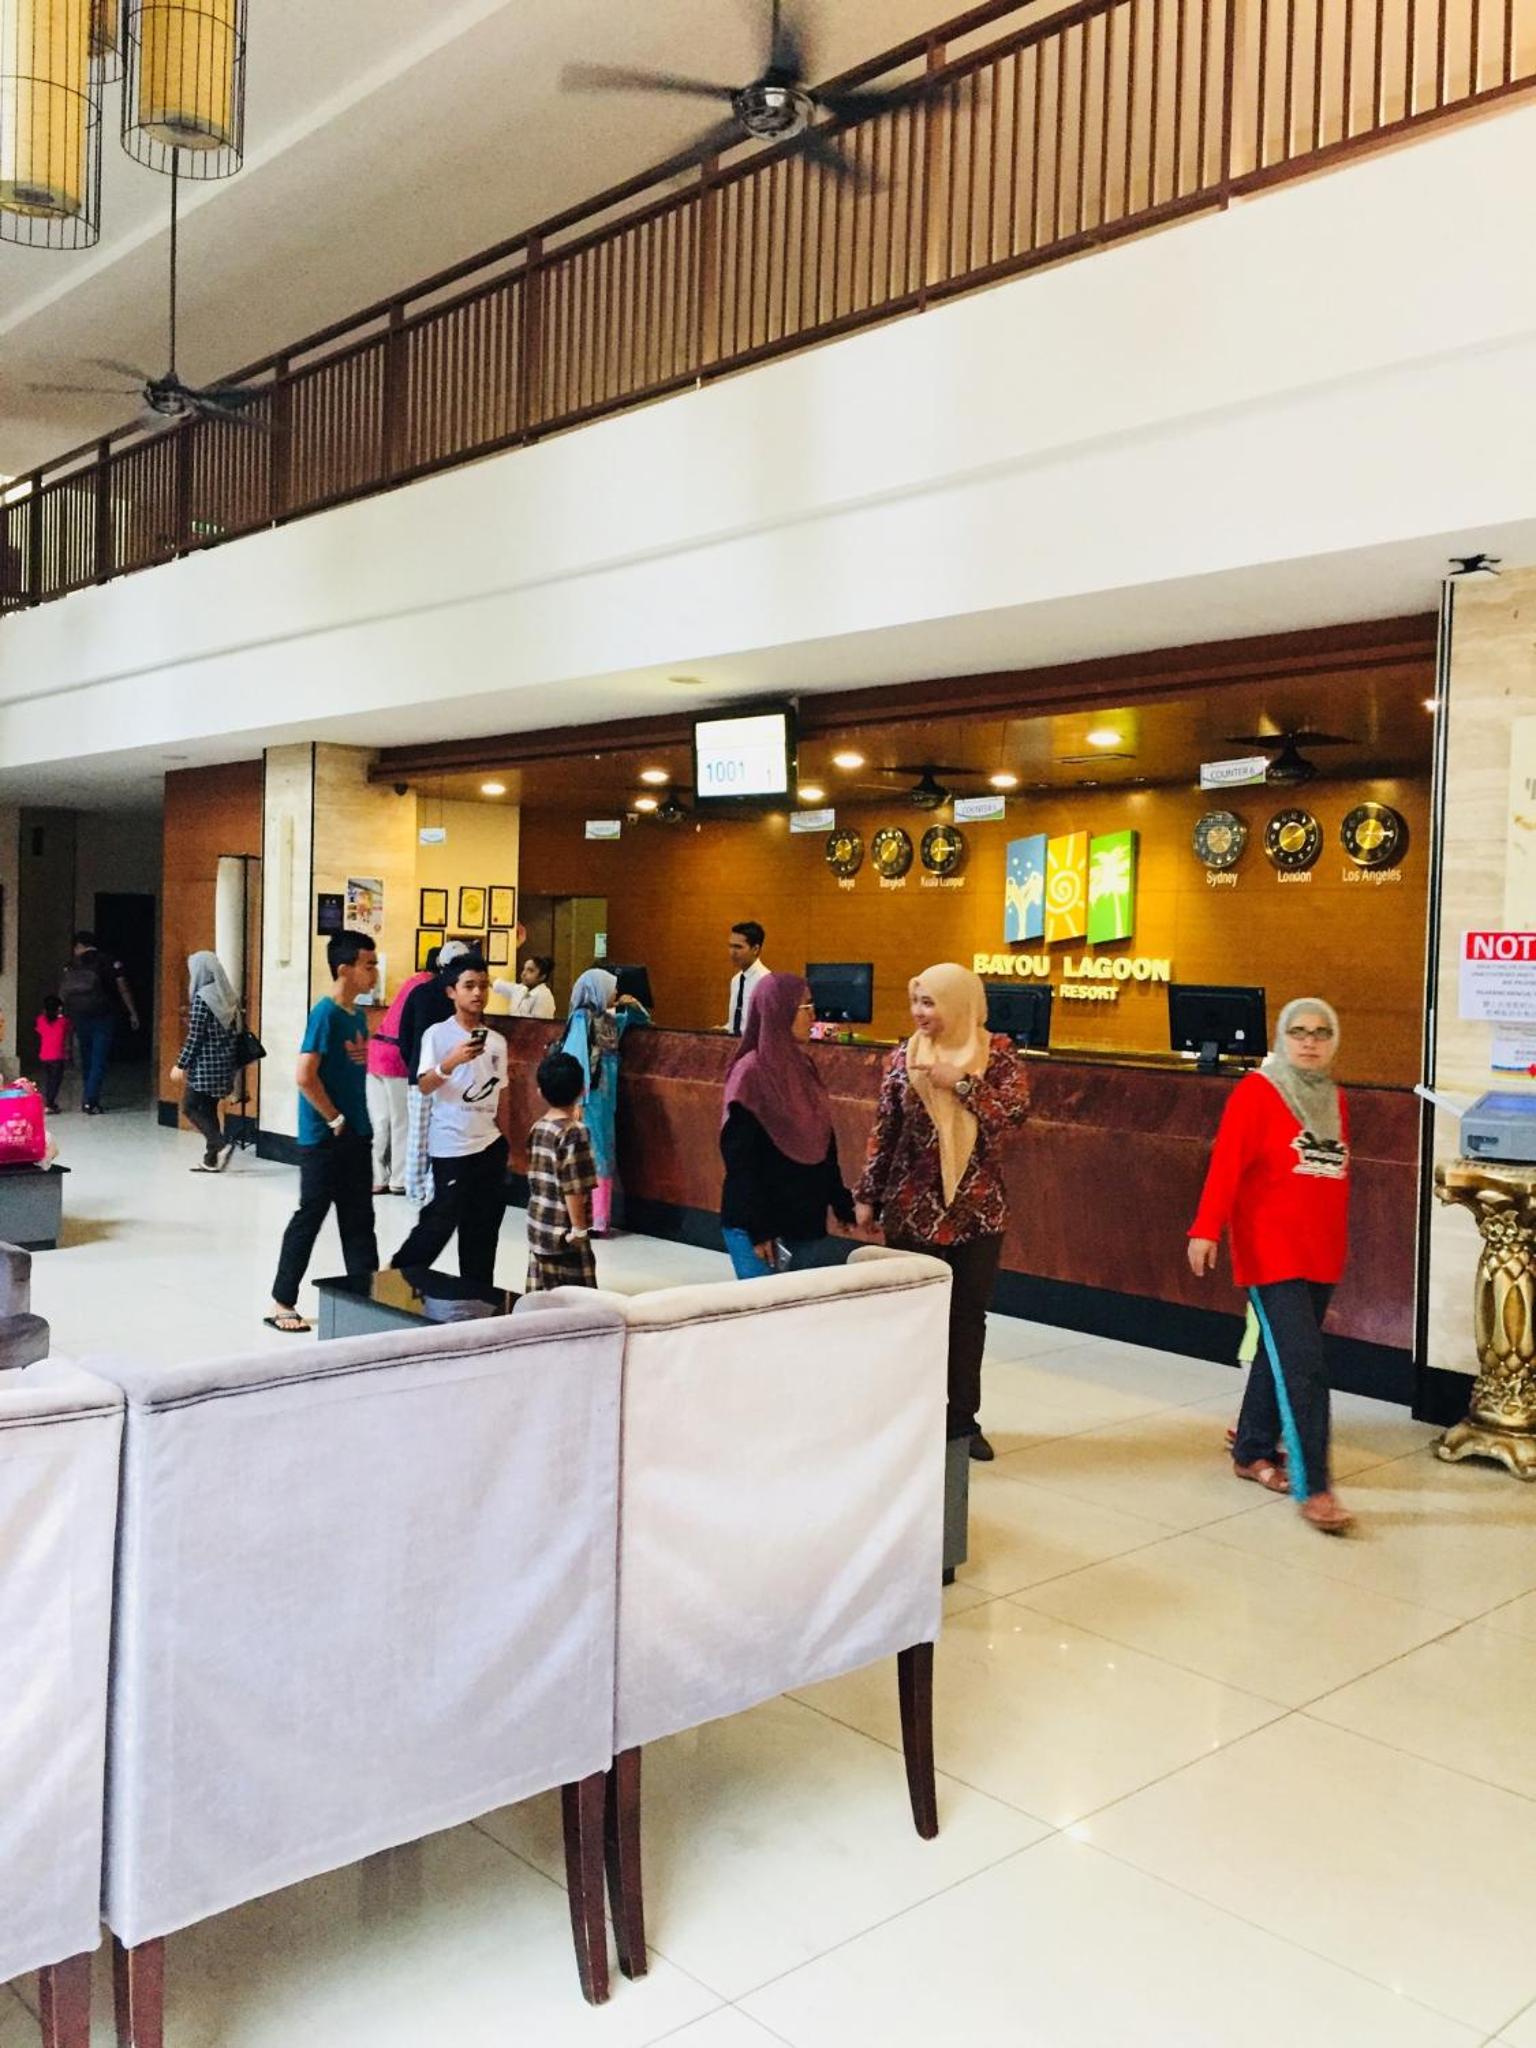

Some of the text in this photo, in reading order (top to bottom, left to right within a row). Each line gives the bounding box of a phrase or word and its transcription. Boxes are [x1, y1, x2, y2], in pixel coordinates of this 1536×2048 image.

[704, 759, 745, 784] 1001
[1210, 767, 1248, 779] COUNTER
[1206, 870, 1238, 888] Sydney
[1278, 869, 1312, 883] London
[1343, 868, 1402, 886] Los Angeles
[973, 952, 1172, 982] BAYOU LAGOON
[1060, 984, 1120, 1001] RESORT
